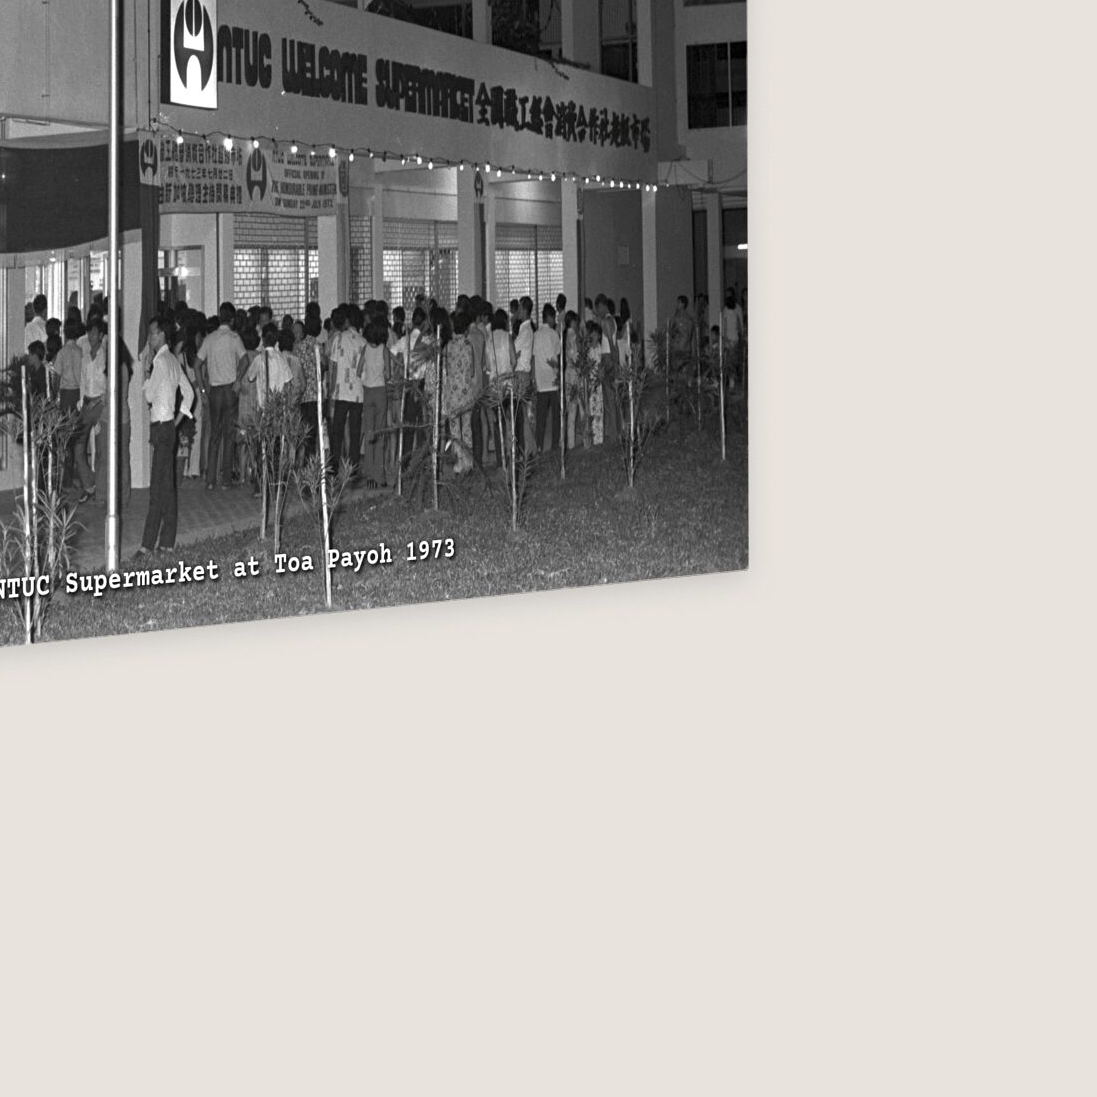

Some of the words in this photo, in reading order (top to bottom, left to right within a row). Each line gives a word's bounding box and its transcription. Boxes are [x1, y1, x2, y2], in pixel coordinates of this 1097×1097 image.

[217, 24, 272, 89] NTUC
[281, 37, 368, 106] WELCOME
[375, 58, 475, 124] SUPERMARKET
